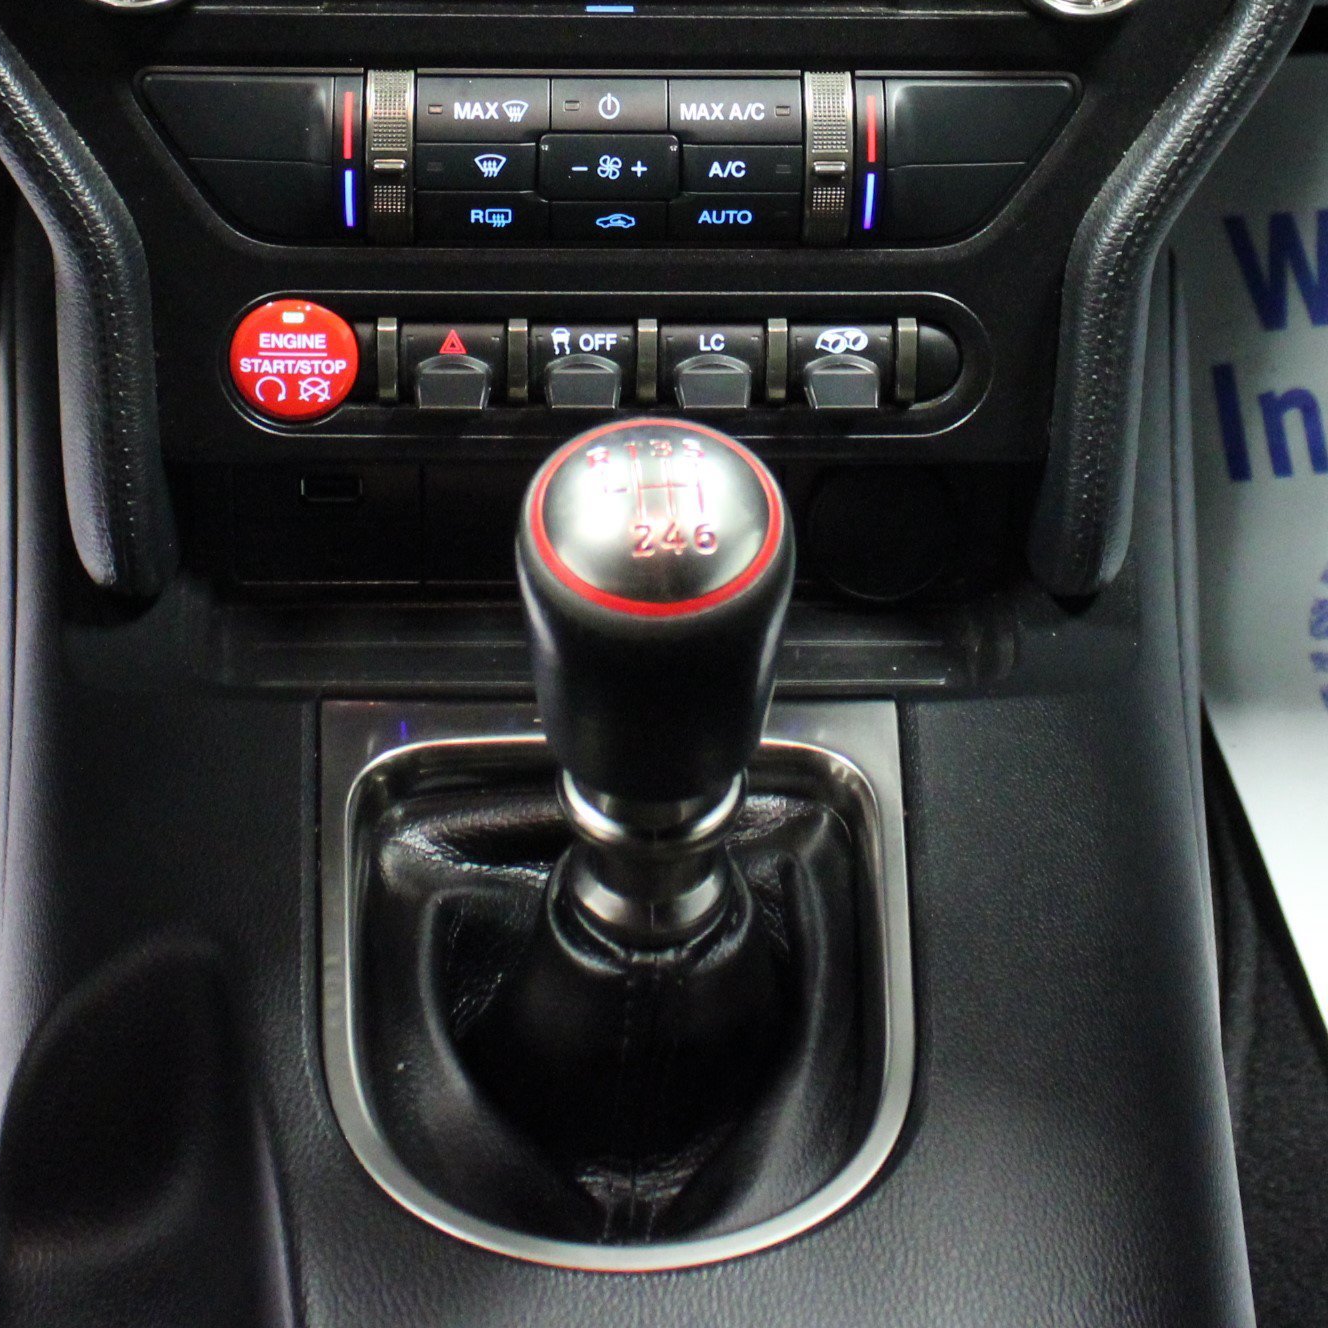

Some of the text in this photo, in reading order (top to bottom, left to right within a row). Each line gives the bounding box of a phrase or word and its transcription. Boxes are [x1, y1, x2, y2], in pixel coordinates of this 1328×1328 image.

[453, 99, 499, 121] MAX
[679, 100, 766, 123] MAX A/C
[708, 158, 747, 180] A/C
[470, 208, 484, 224] R
[697, 208, 753, 226] AUTO
[259, 332, 327, 350] ENGINE
[578, 332, 618, 352] OFF
[699, 333, 725, 352] LC
[239, 357, 347, 375] START/STOP
[692, 522, 718, 555] 6
